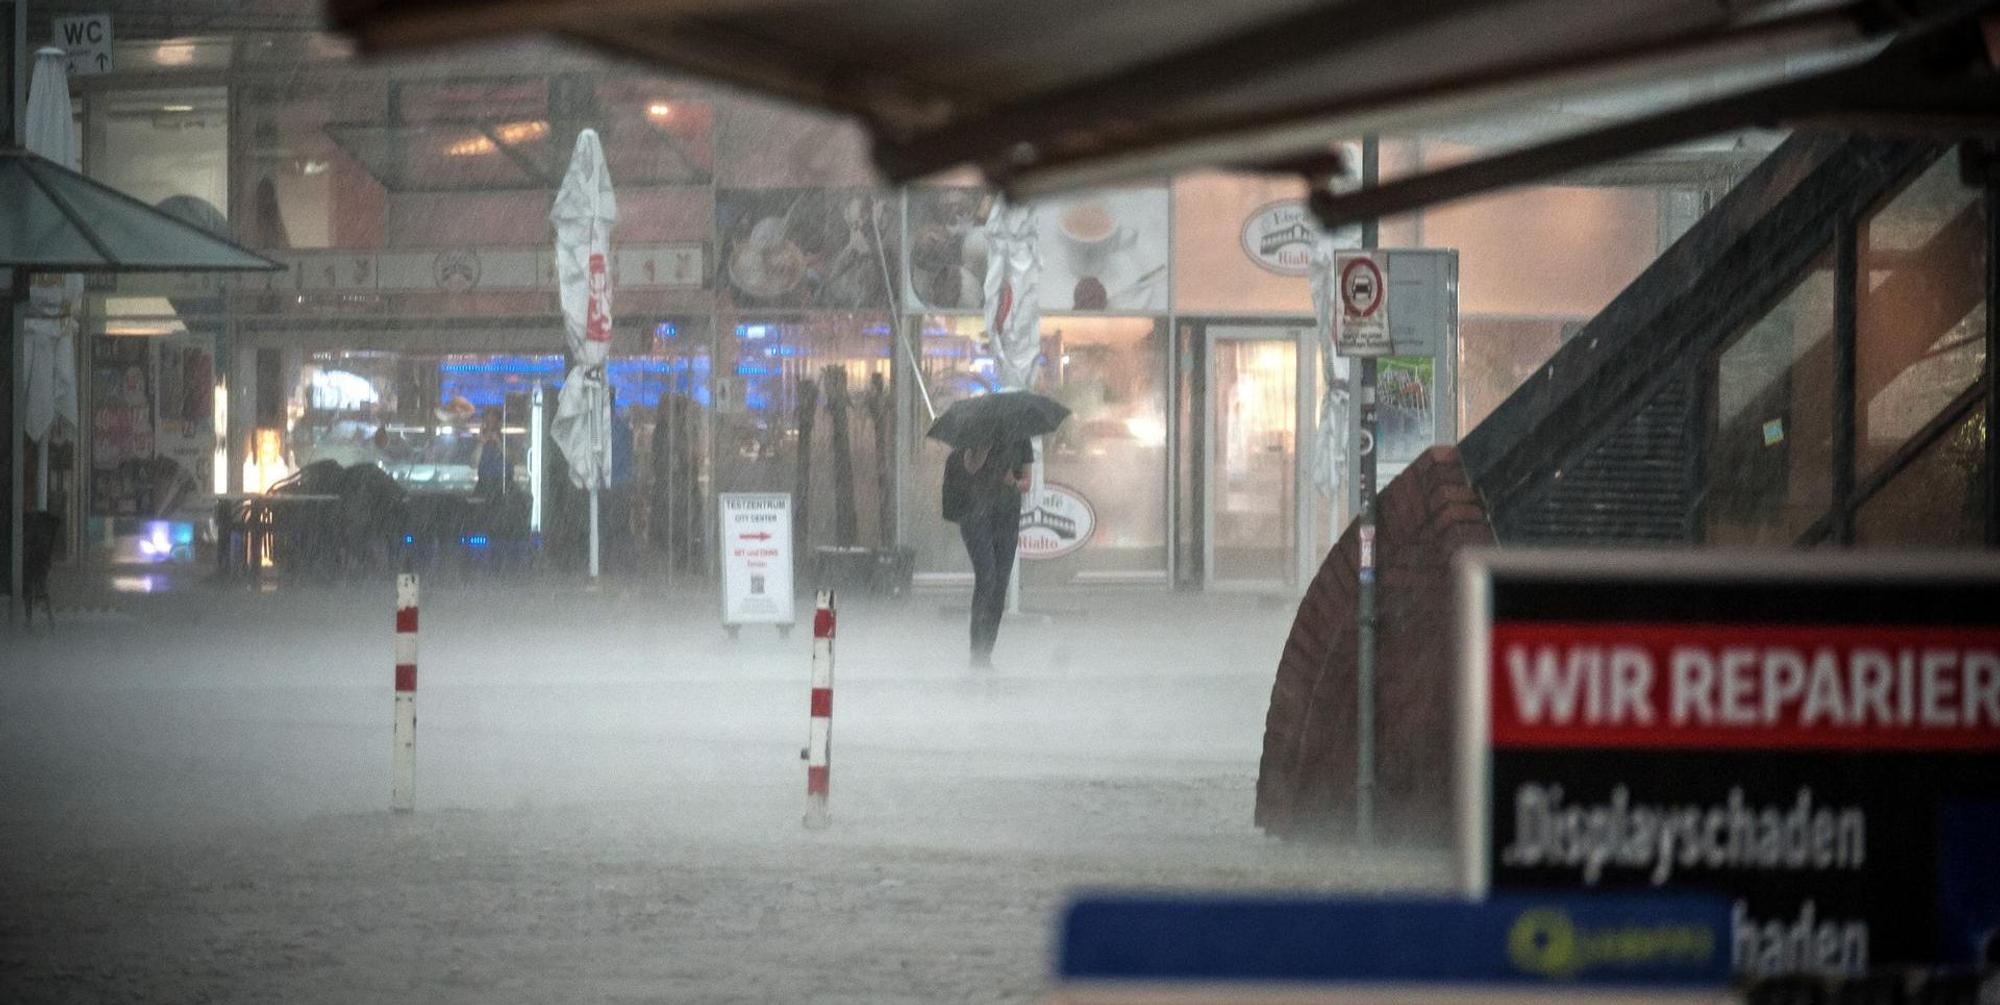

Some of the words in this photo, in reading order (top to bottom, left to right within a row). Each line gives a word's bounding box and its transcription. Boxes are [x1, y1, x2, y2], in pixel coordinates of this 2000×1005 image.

[63, 20, 103, 45] WC
[726, 499, 786, 510] TESTZENTRUM
[1506, 643, 1656, 728] WIR
[1668, 646, 2000, 730] REPARIER
